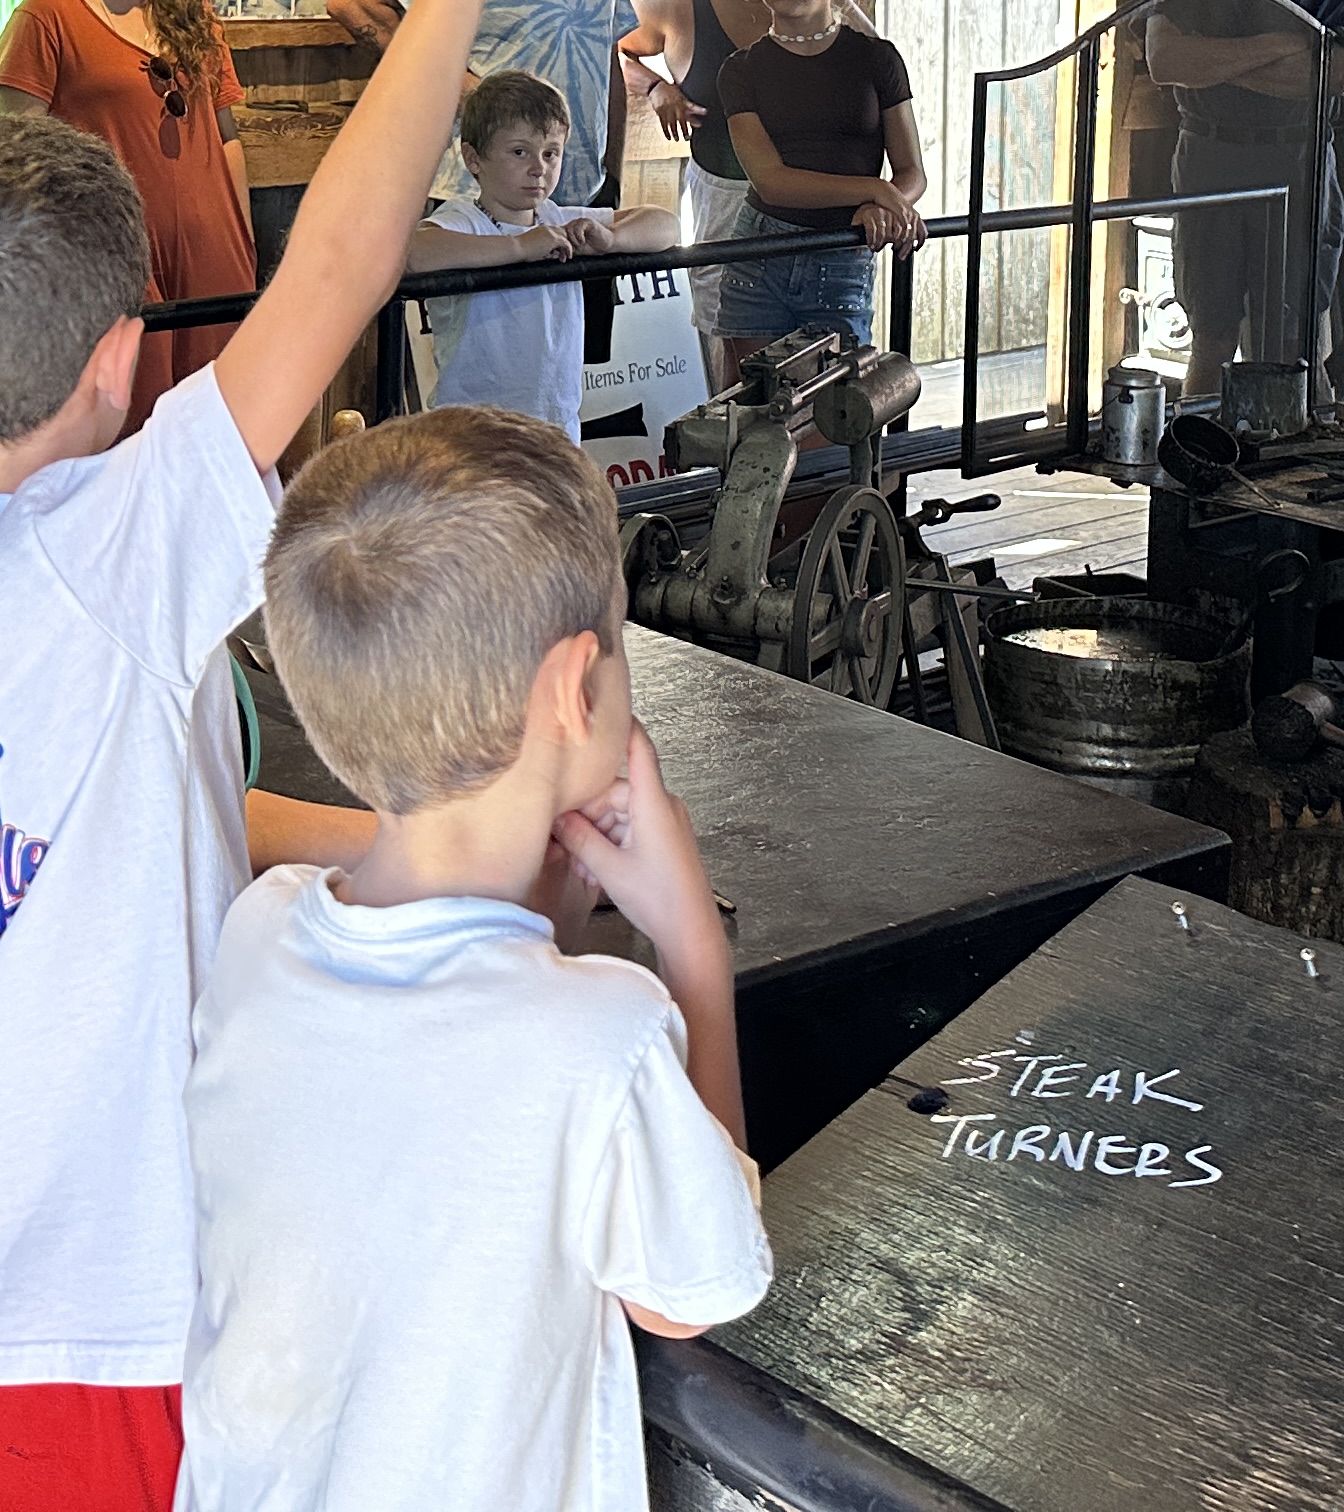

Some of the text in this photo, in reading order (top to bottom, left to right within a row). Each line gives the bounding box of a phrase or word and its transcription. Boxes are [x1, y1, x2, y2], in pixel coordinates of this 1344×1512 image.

[583, 355, 688, 391] Items For Sale
[939, 1049, 1205, 1113] STEAK
[929, 1113, 1224, 1188] TURNERS
